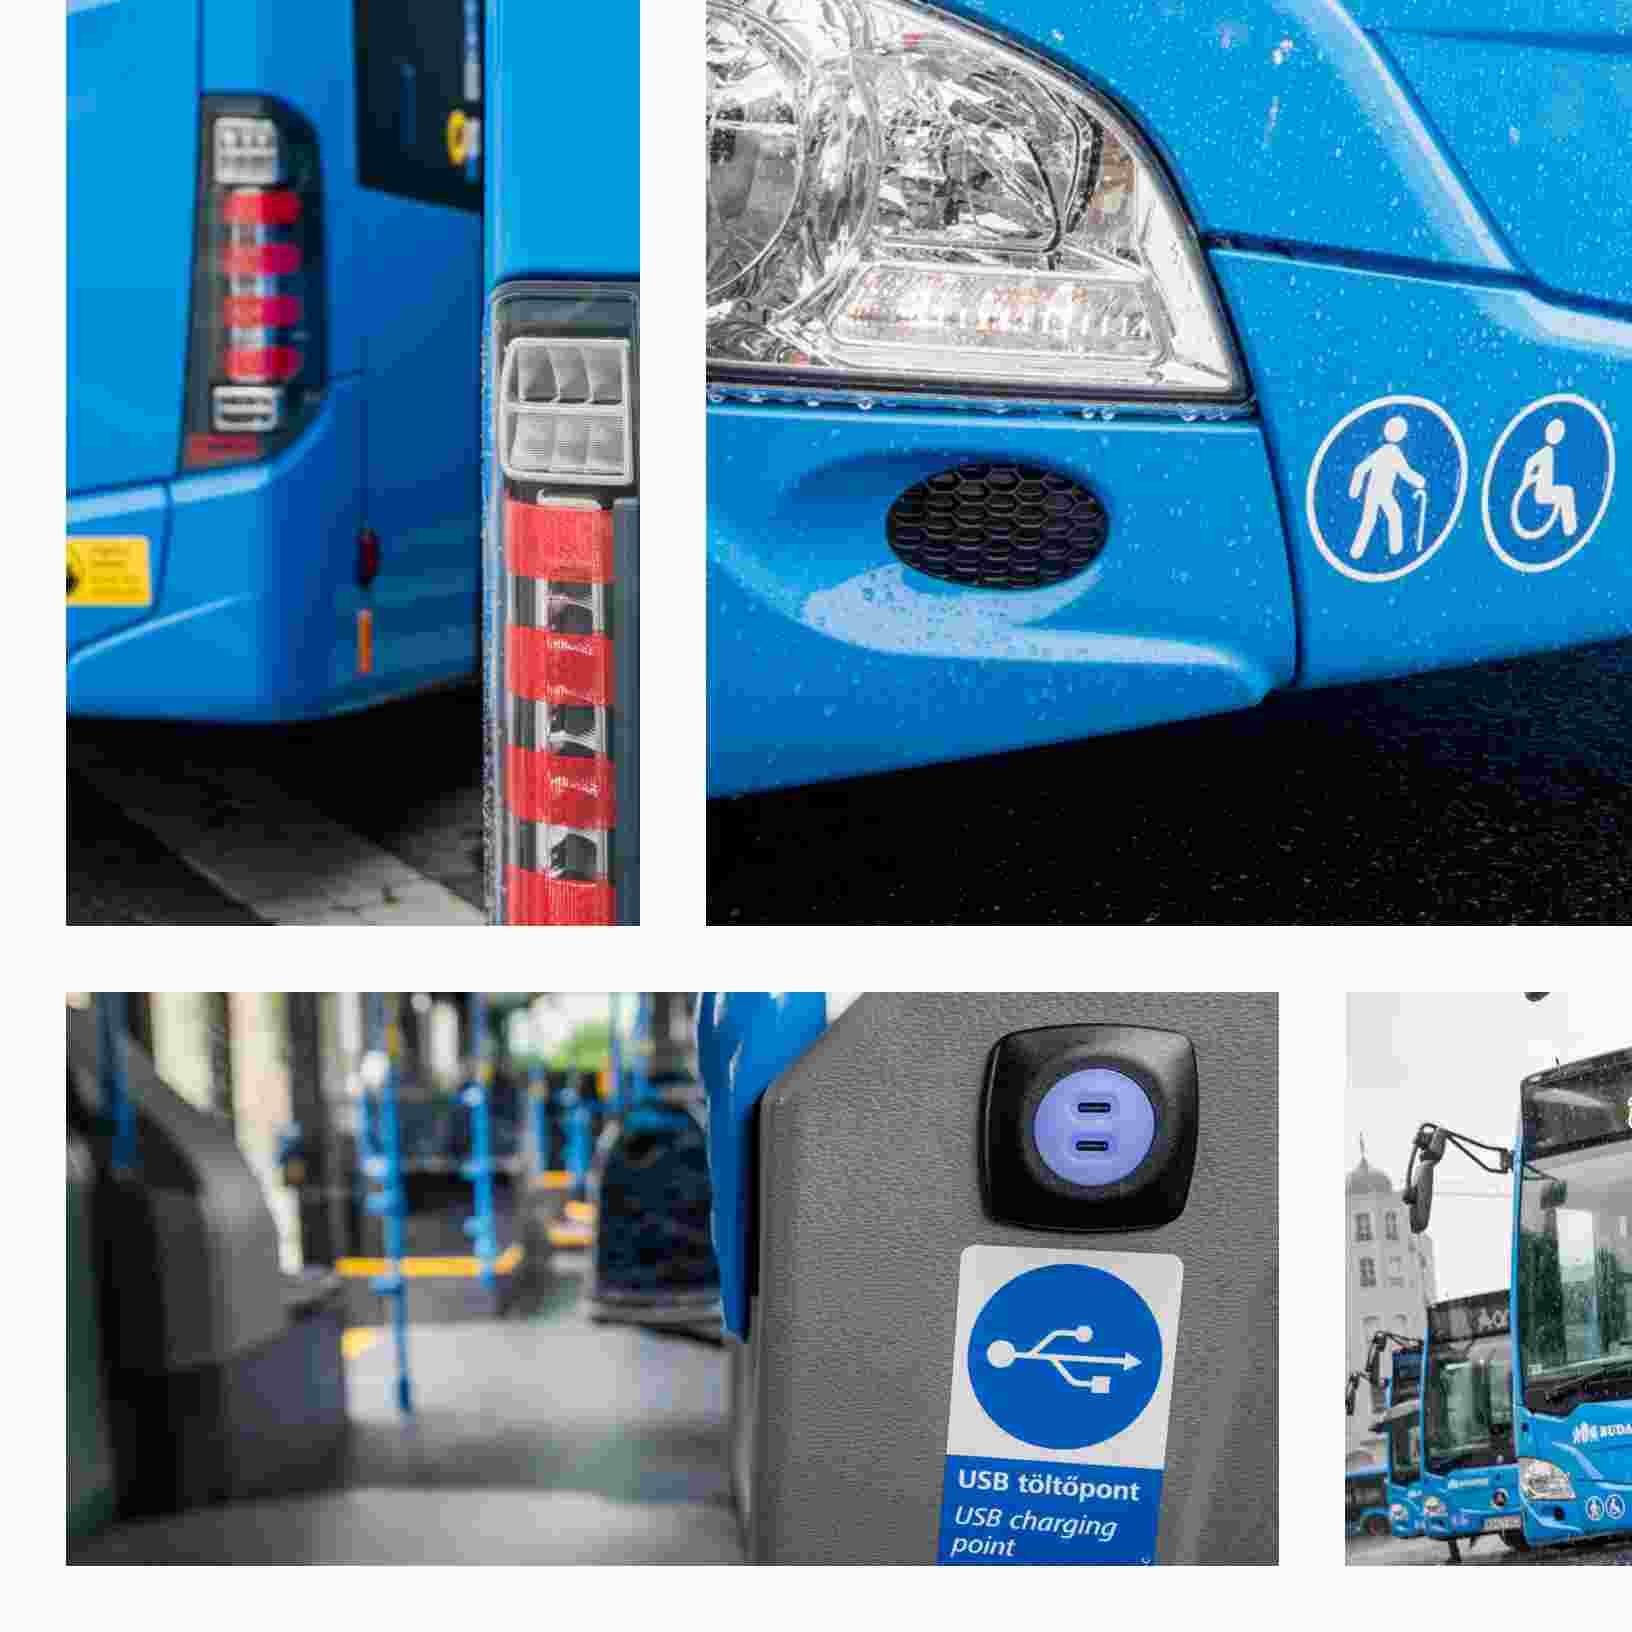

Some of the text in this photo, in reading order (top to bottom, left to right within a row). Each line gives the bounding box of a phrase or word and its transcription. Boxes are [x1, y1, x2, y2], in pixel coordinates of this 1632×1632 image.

[958, 1469, 1141, 1504] USB töltőpont
[954, 1505, 1119, 1543] USB charging
[949, 1535, 1017, 1558] point
